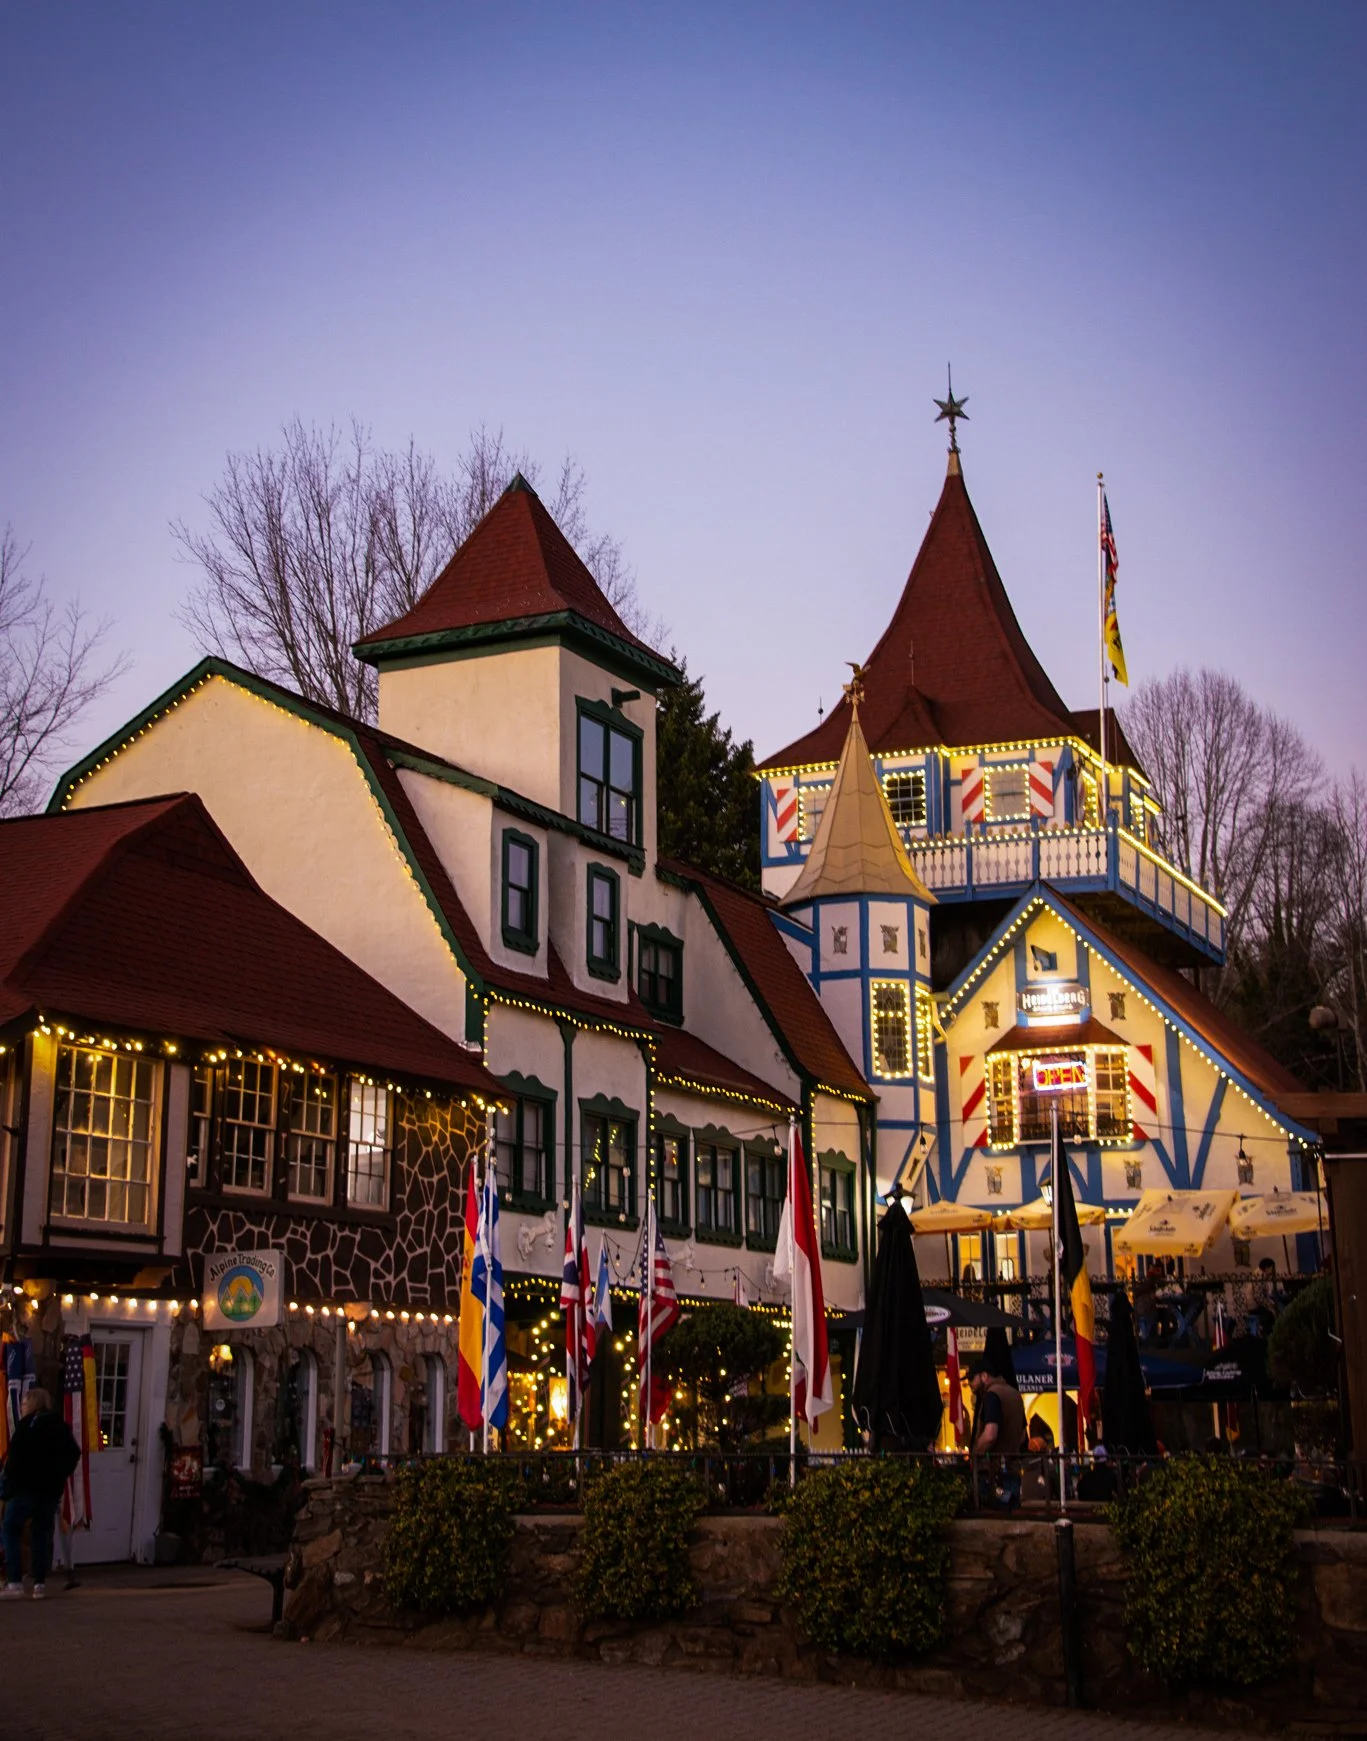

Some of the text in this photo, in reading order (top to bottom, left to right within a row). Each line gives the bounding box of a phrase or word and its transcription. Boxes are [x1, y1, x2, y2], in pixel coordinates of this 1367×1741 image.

[1037, 1065, 1086, 1086] OPEN
[211, 1257, 237, 1281] Alpine
[238, 1253, 267, 1274] Trading
[1016, 1373, 1054, 1384] ULANER
